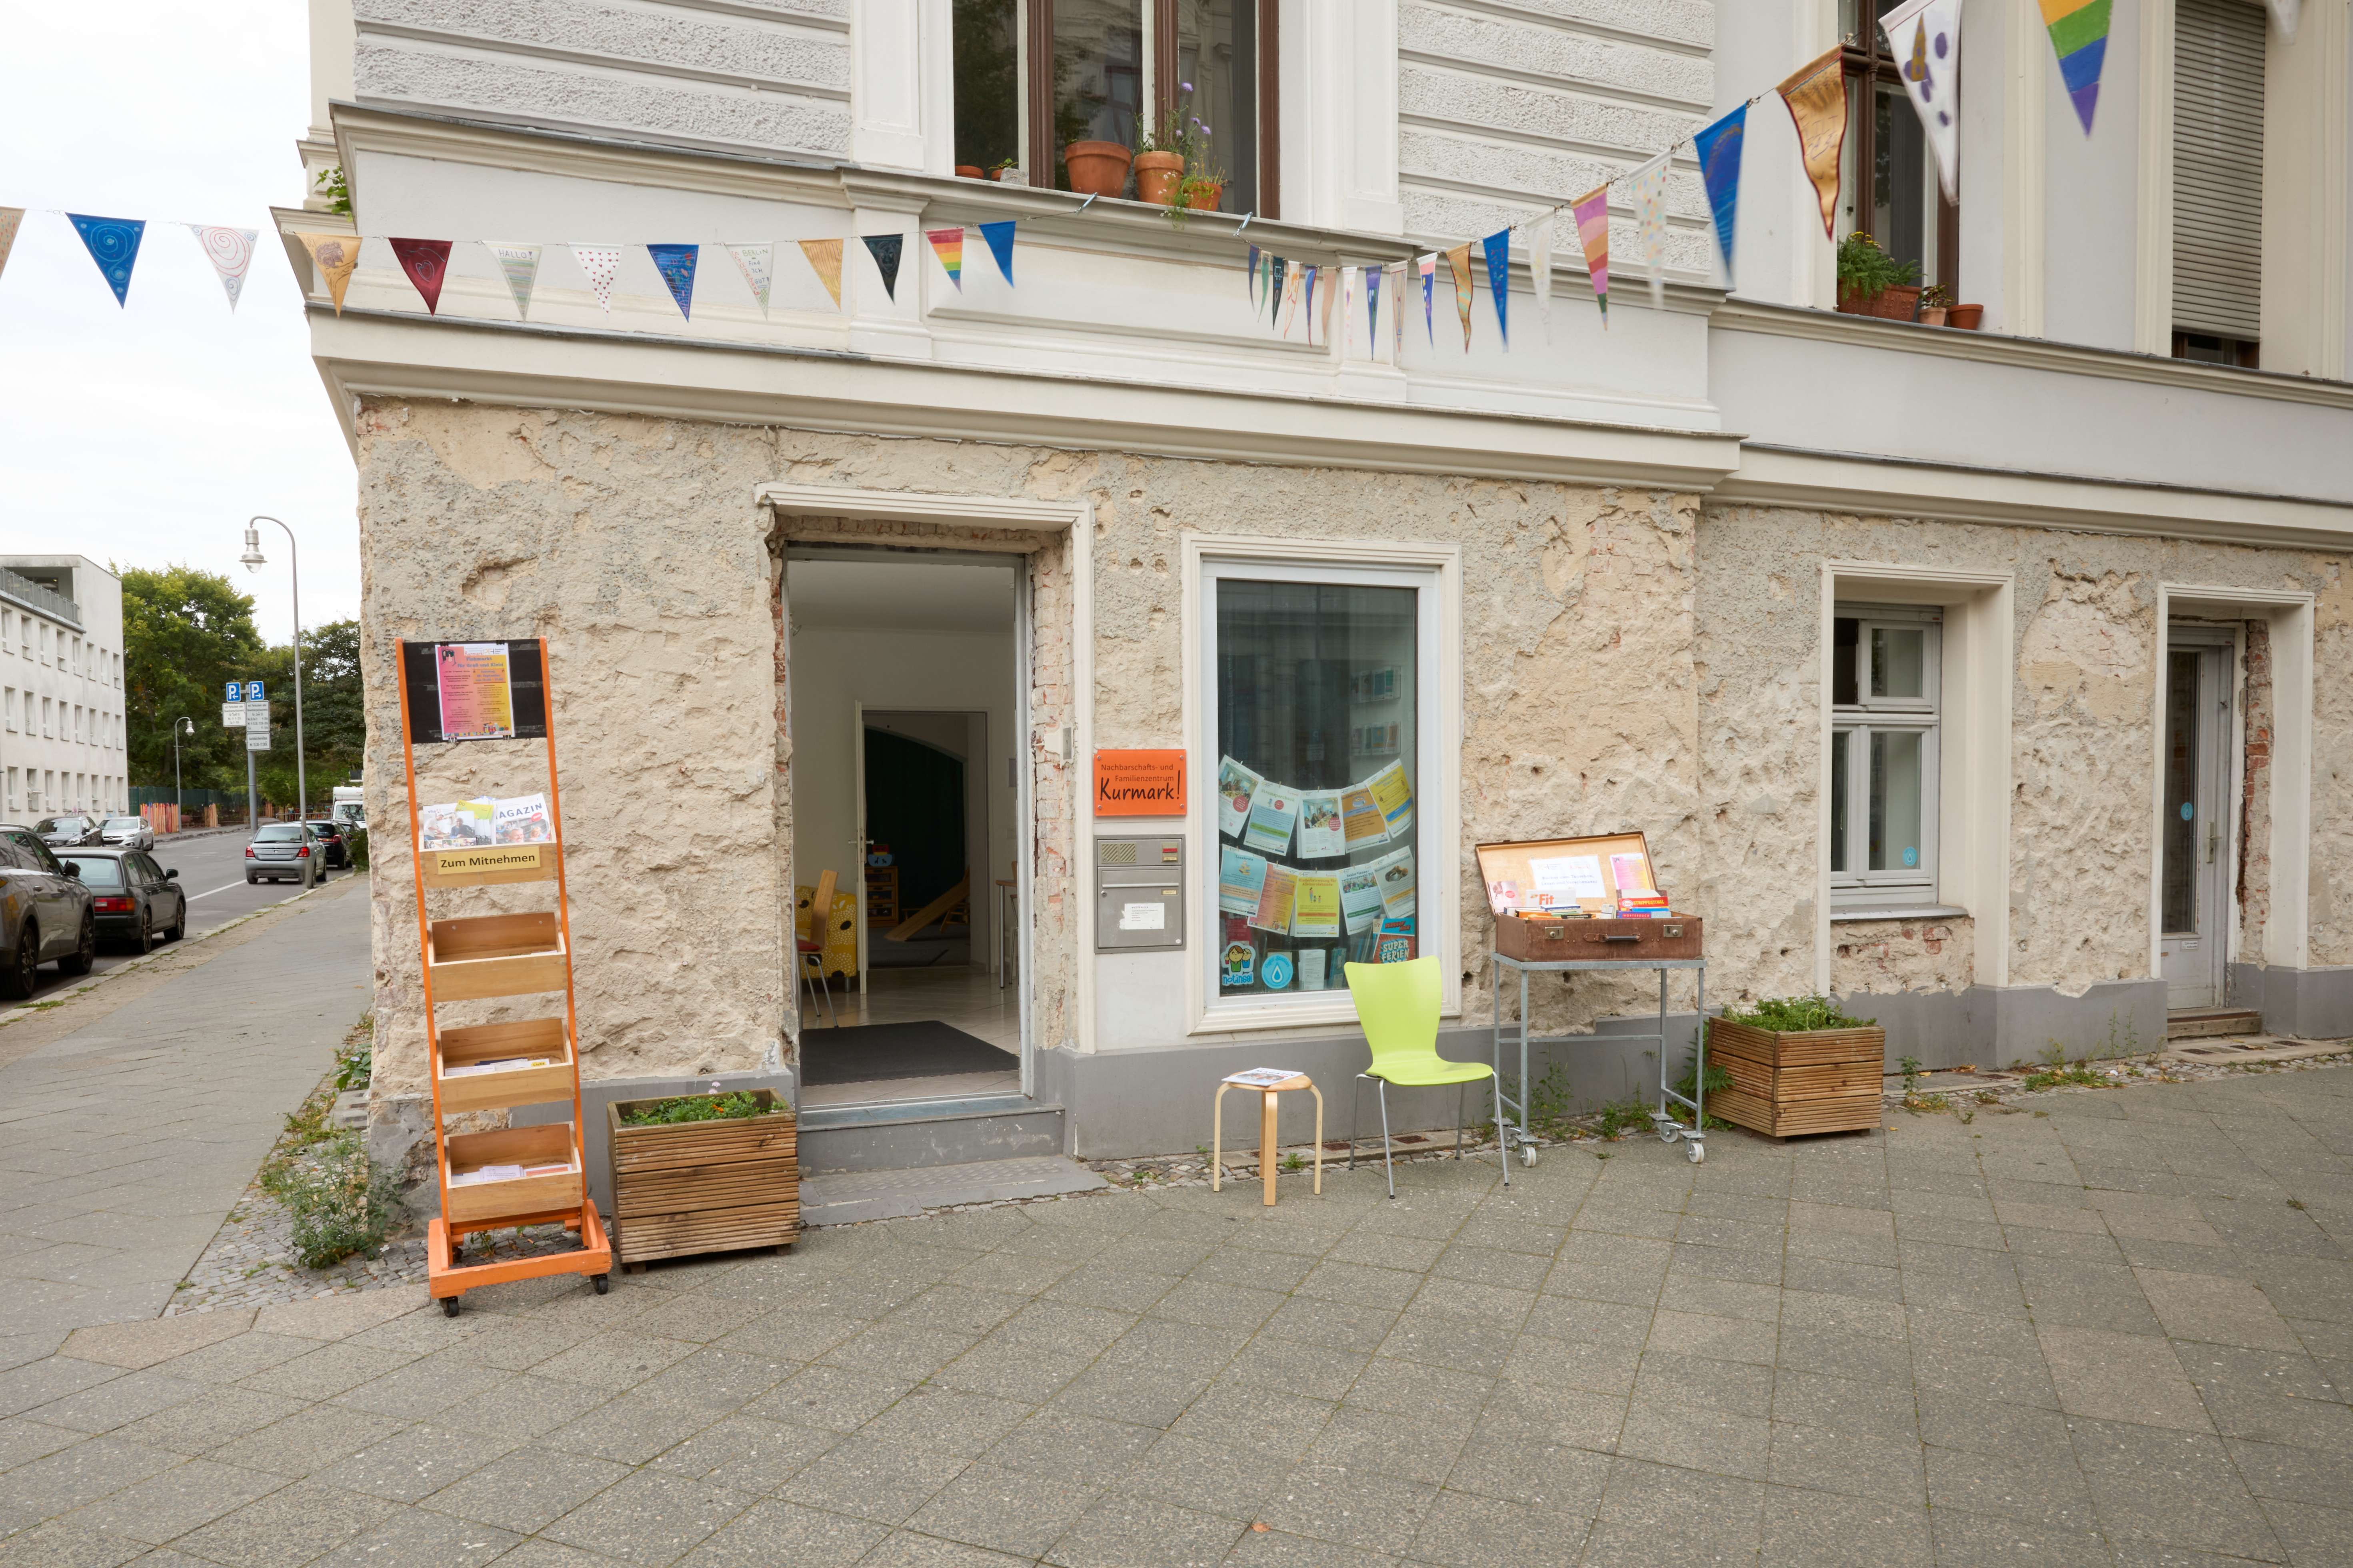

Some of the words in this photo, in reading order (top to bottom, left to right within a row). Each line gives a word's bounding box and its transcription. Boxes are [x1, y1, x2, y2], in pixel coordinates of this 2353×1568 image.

[498, 248, 532, 260] HALLO!
[228, 685, 236, 699] P
[251, 684, 260, 698] P
[1100, 770, 1180, 801] Kurmark!
[496, 803, 542, 819] AGAZIN
[441, 859, 466, 868] Zum
[470, 855, 535, 866] Mitnehmen
[1539, 894, 1554, 905] Fit
[1383, 940, 1409, 952] SUPER
[1381, 948, 1409, 962] FERIEN
[1223, 974, 1253, 984] notinsel
